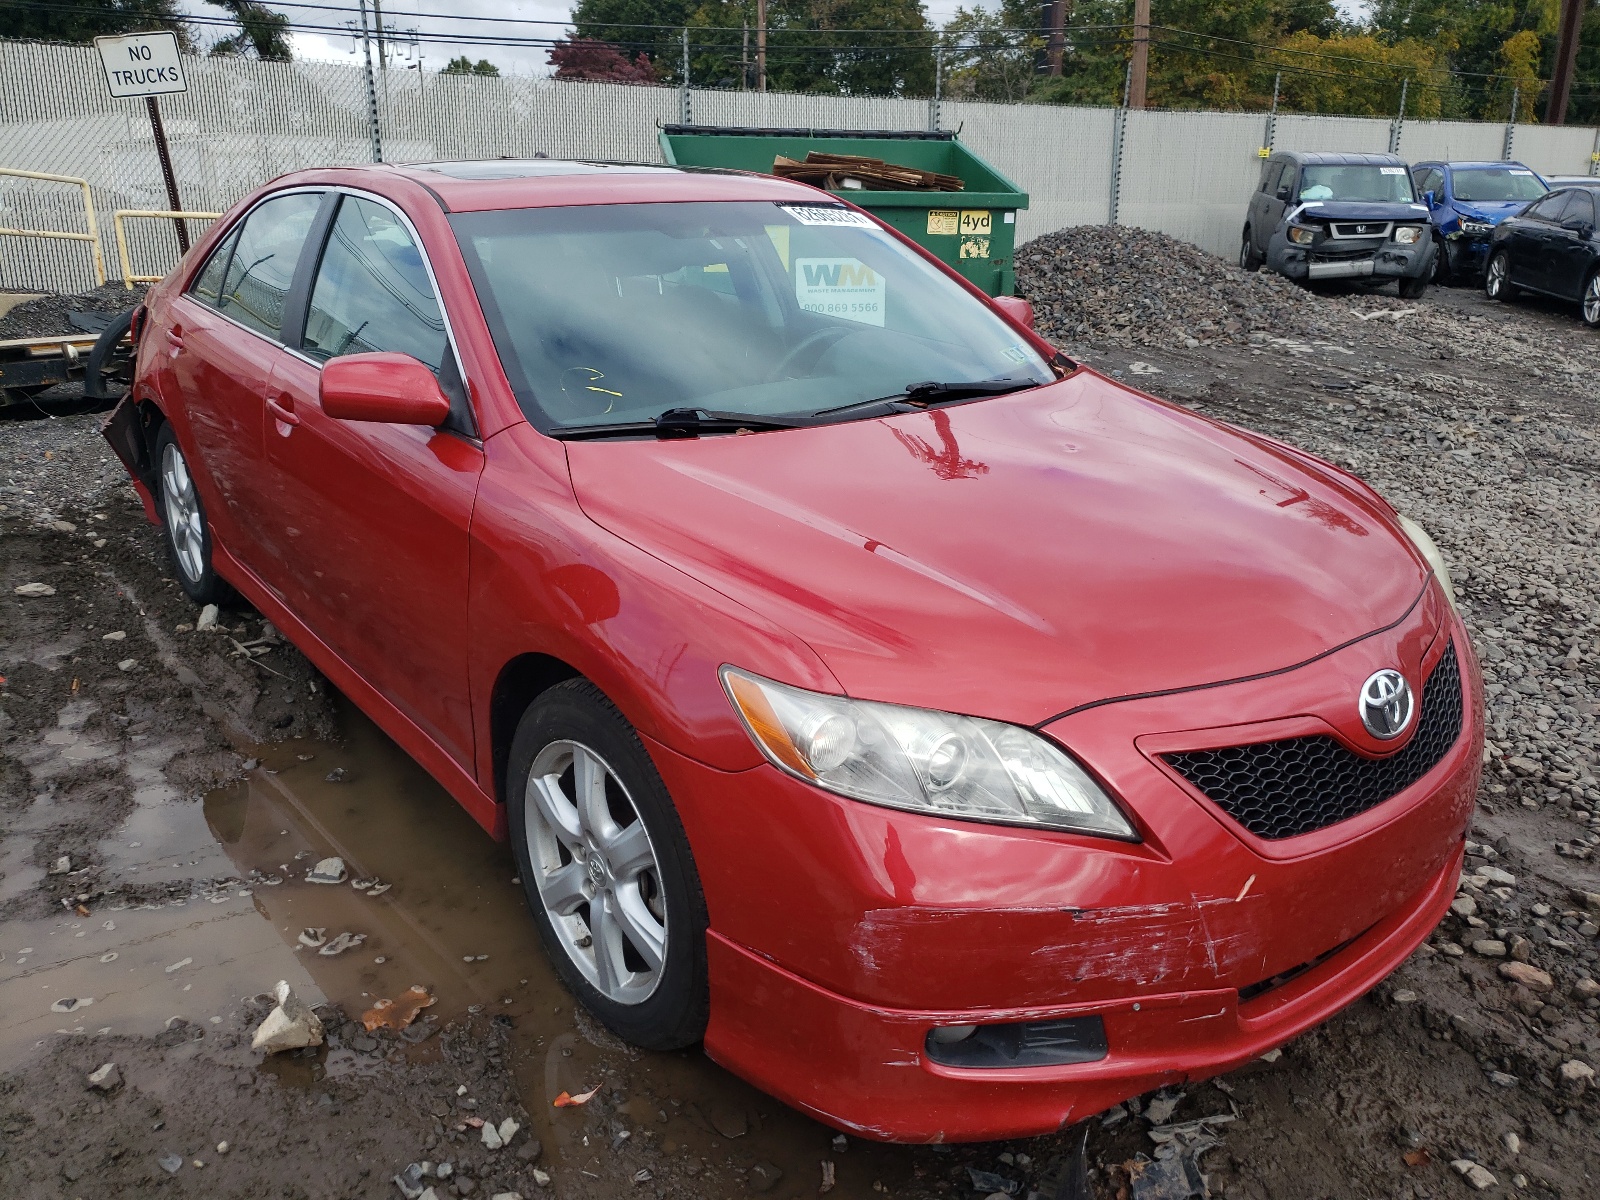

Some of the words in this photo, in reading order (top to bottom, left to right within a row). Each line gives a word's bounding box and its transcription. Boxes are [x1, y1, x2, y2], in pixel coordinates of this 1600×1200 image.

[128, 45, 151, 61] NO
[112, 66, 178, 85] TRUCKS
[962, 214, 990, 231] 4yd
[802, 264, 876, 287] WM
[804, 303, 825, 312] 800
[827, 303, 848, 312] 869
[851, 303, 878, 312] 5566
